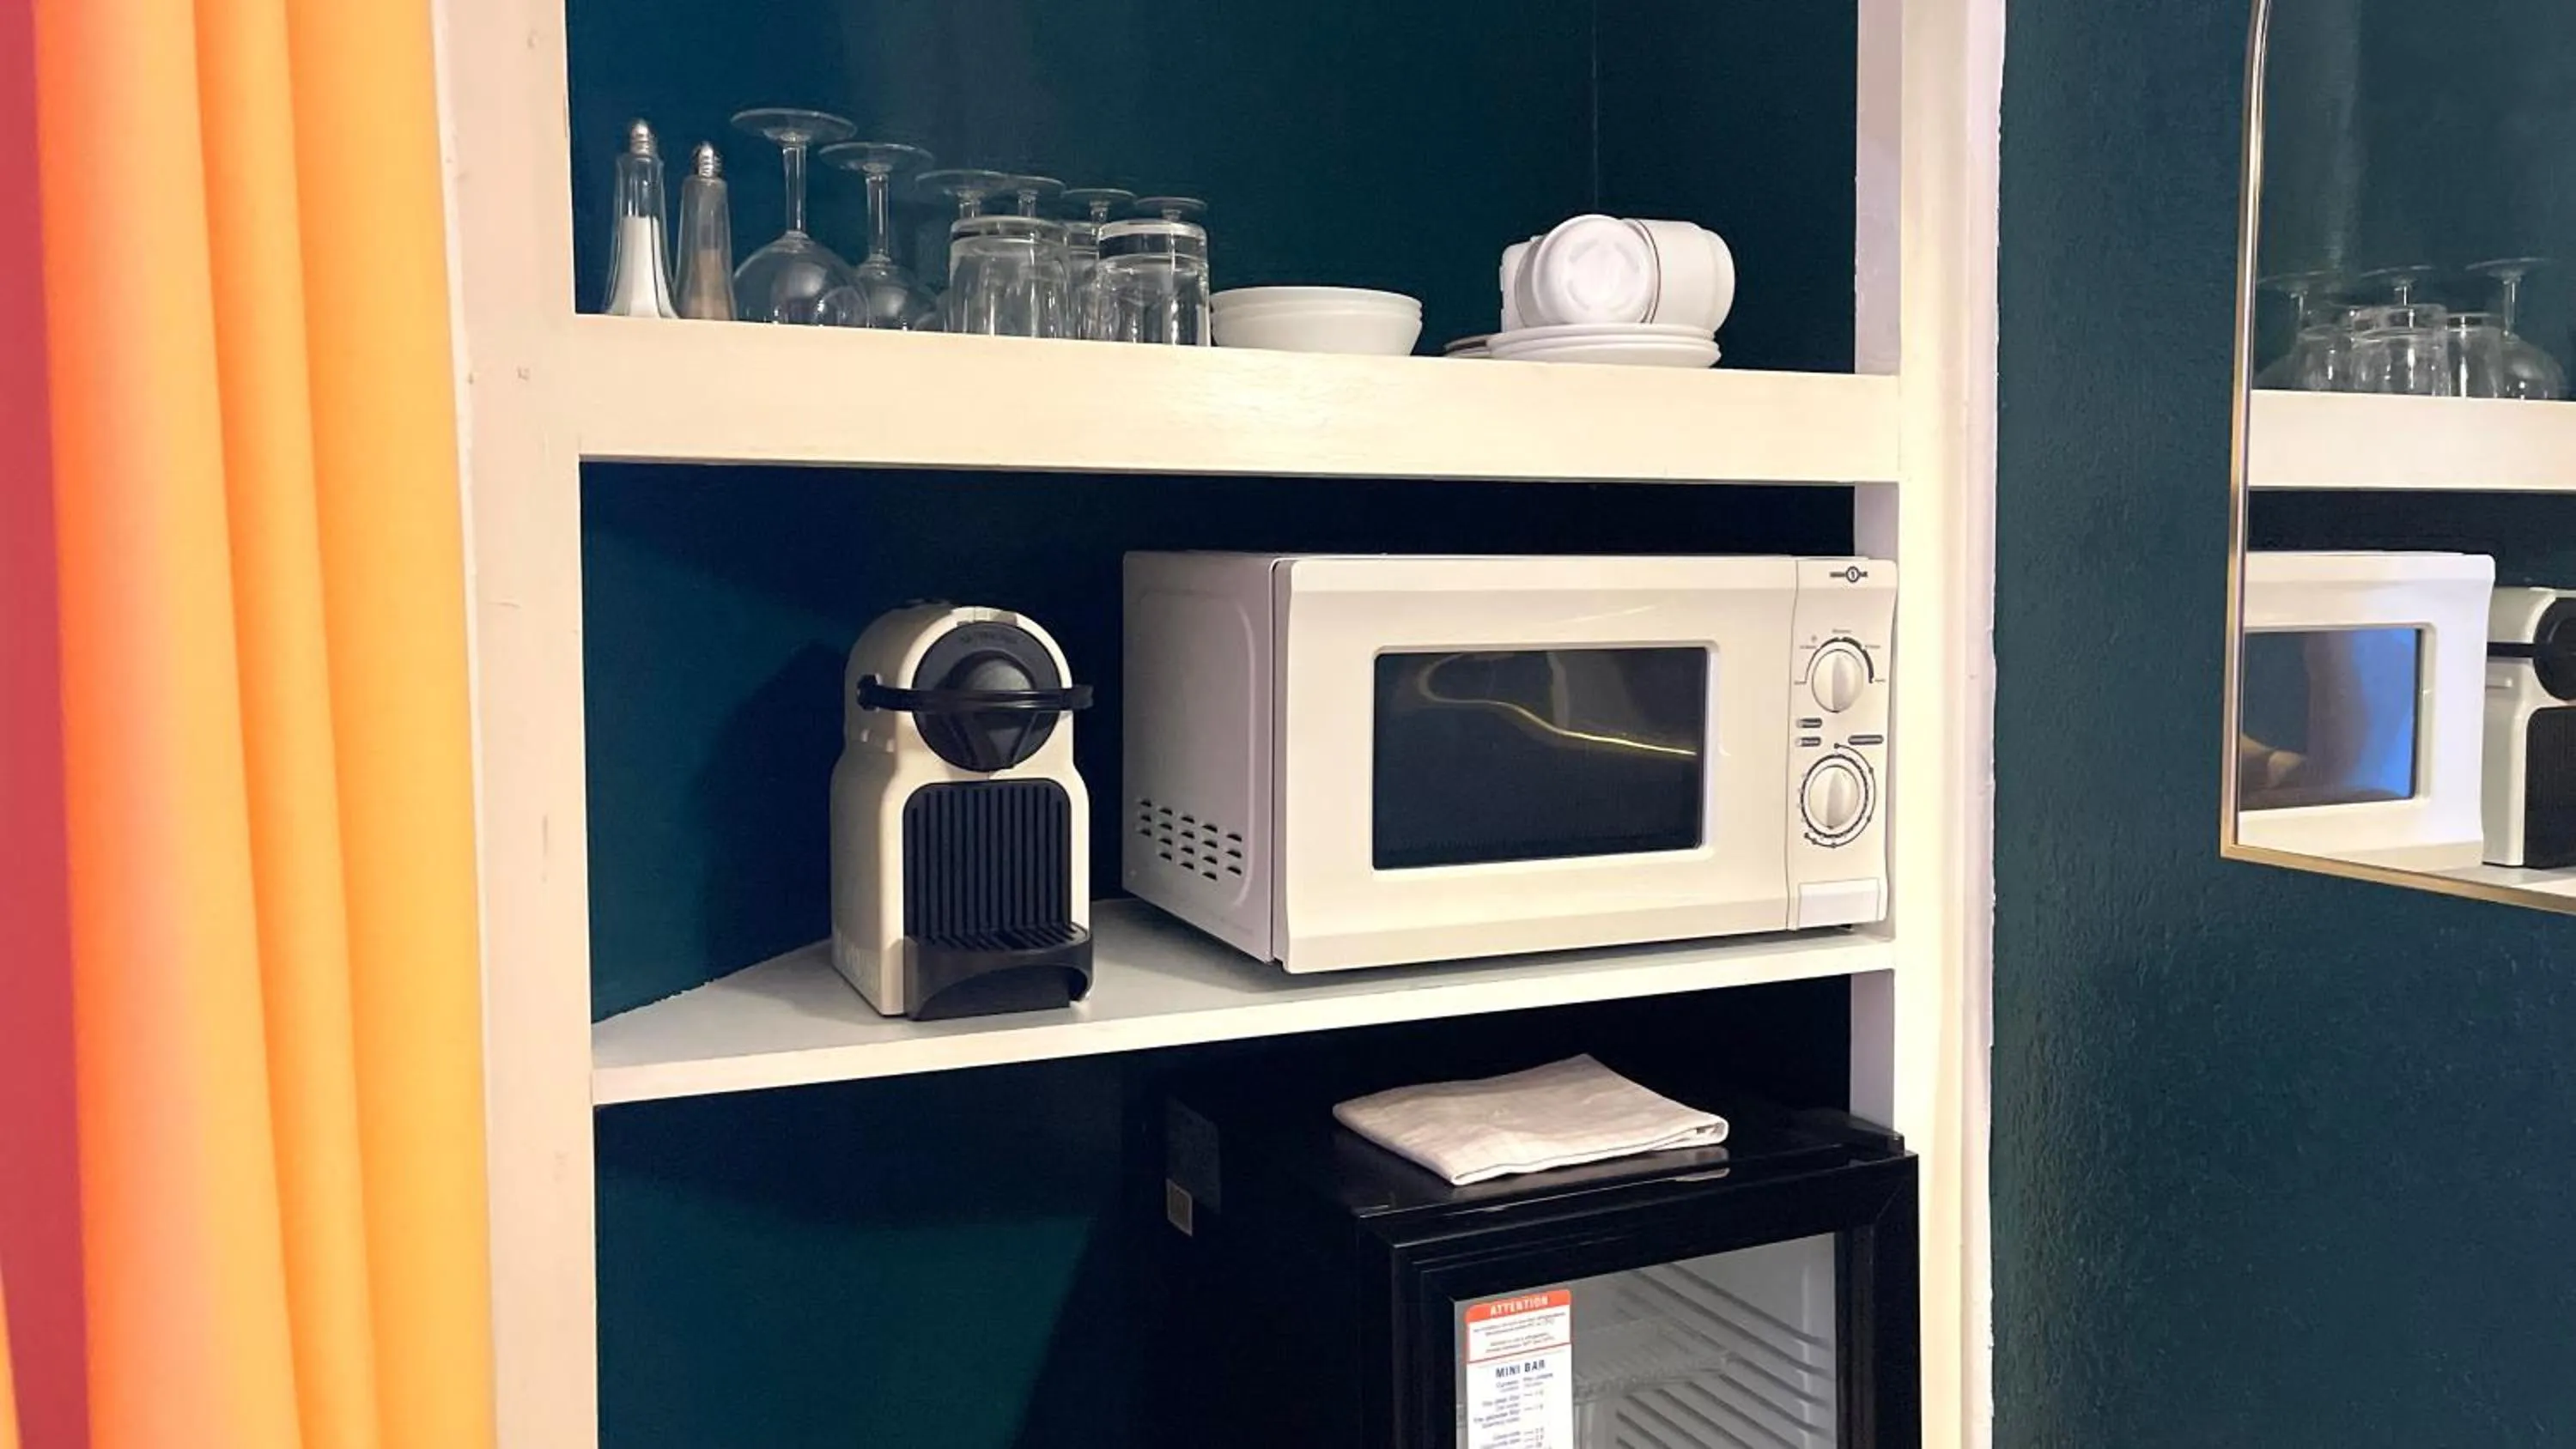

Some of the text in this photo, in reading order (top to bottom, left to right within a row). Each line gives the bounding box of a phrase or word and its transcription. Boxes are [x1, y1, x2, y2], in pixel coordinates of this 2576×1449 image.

[1490, 1295, 1548, 1315] ATTENTION
[1496, 1360, 1546, 1378] MINI BAR
